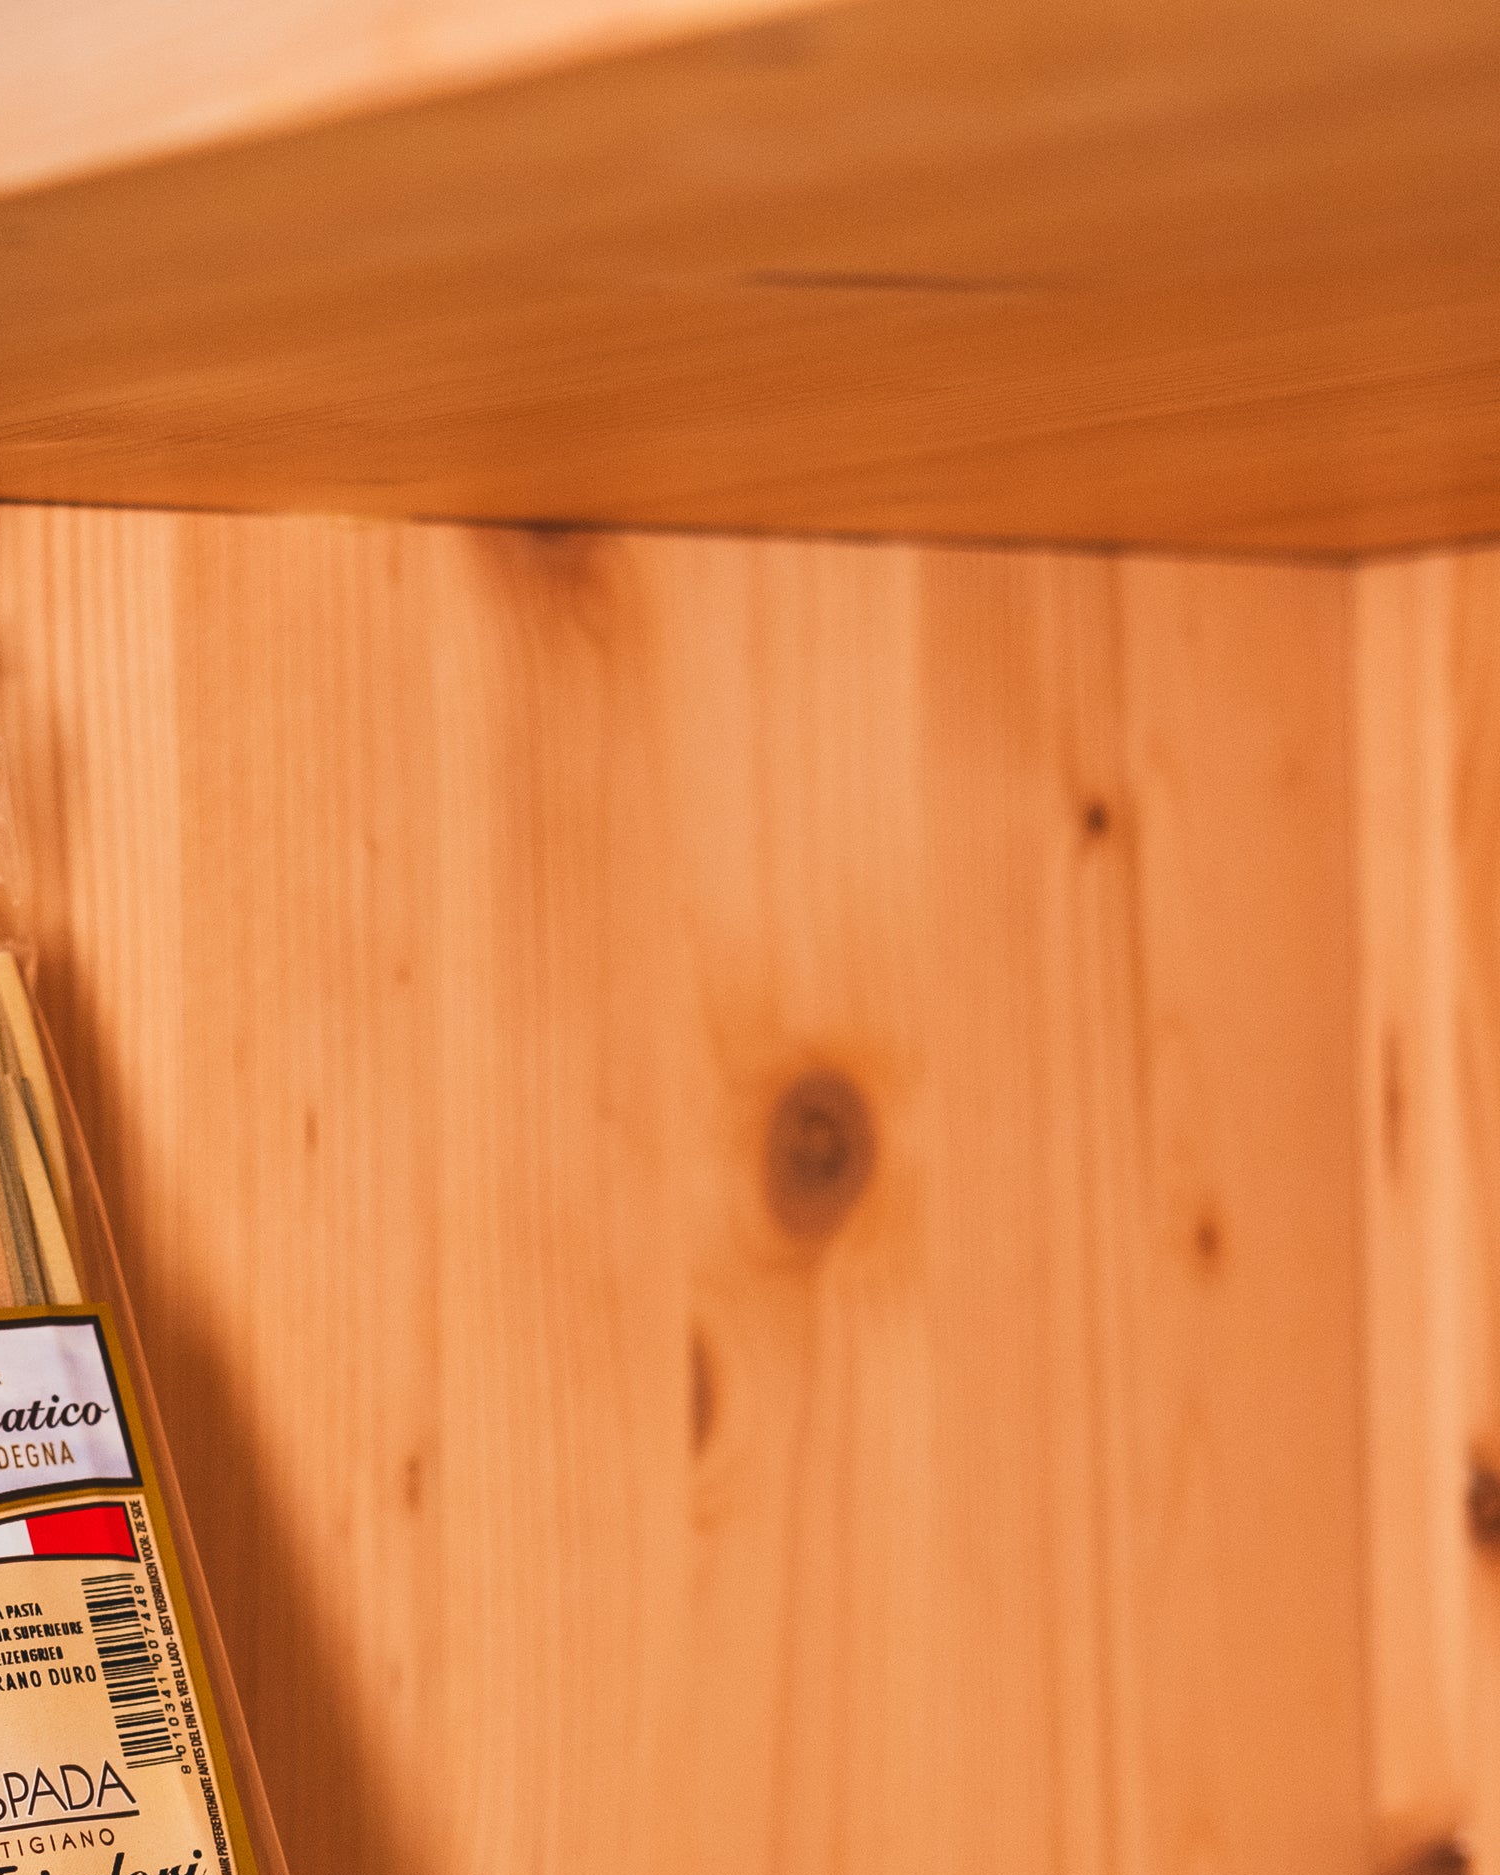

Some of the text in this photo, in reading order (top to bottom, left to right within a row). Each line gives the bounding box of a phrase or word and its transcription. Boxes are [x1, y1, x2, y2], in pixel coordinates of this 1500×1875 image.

[5, 1603, 42, 1618] PASTA
[13, 1621, 83, 1639] SUPERIEURE
[48, 1665, 95, 1685] DURO
[189, 1729, 201, 1746] DEL
[192, 1747, 208, 1775] ANTES
[200, 1777, 227, 1855] PREFERENTEMENTE
